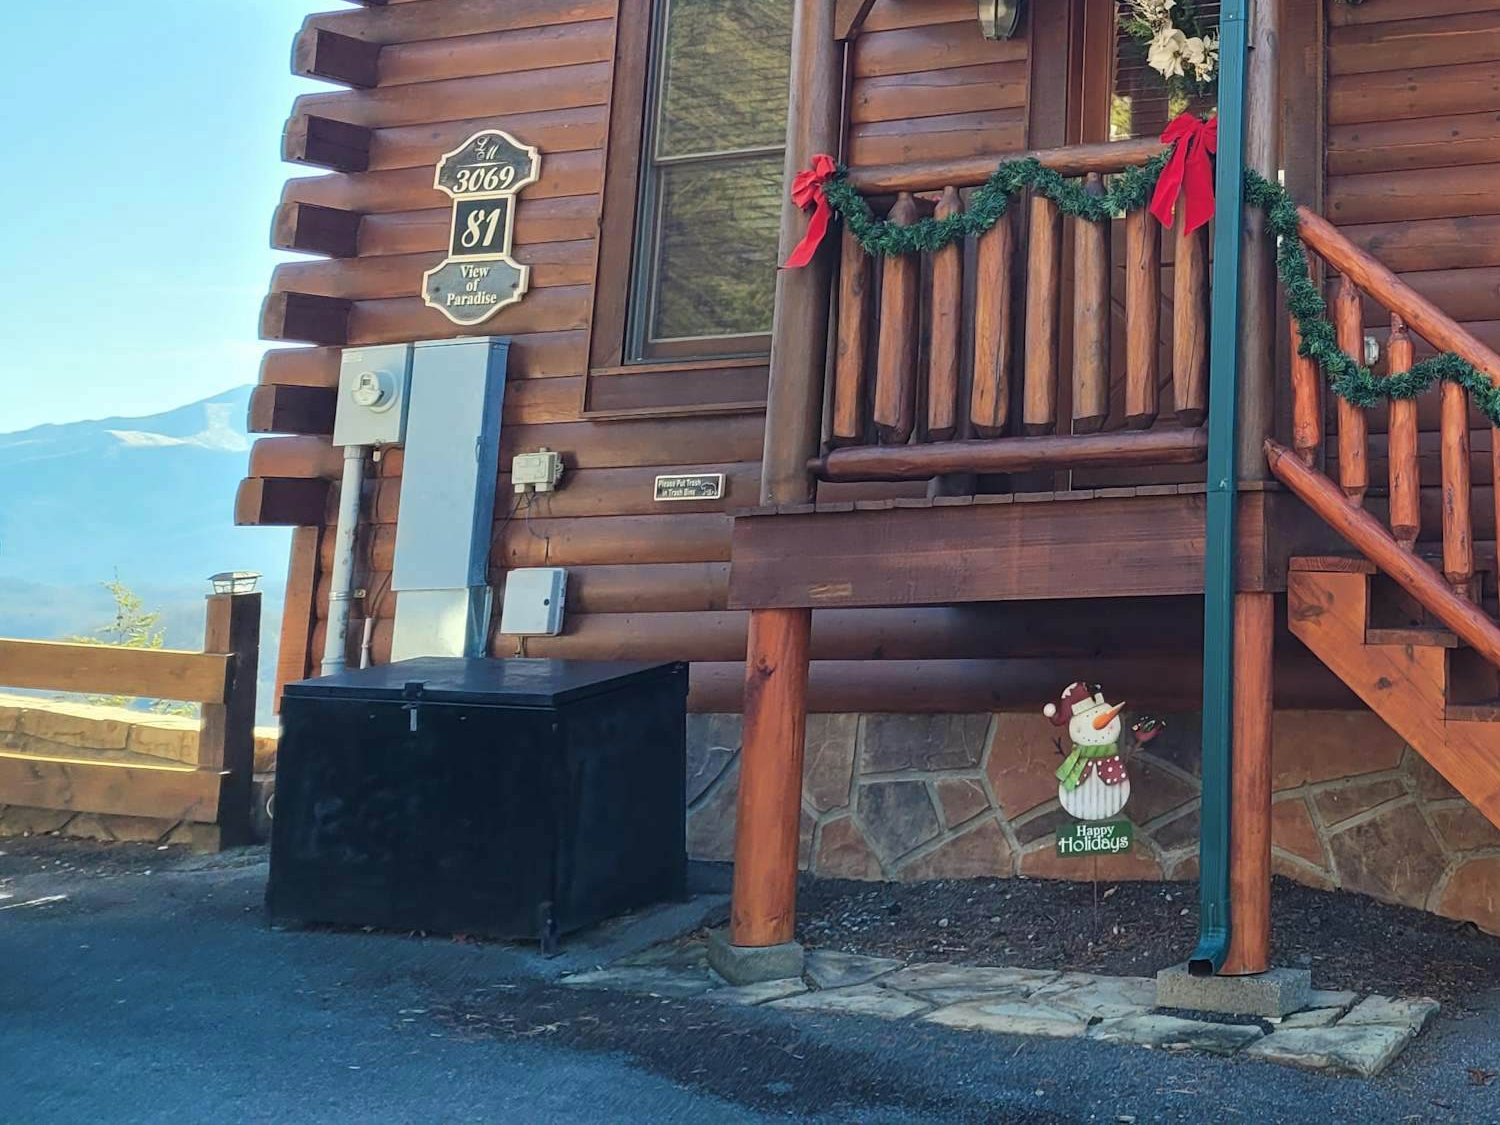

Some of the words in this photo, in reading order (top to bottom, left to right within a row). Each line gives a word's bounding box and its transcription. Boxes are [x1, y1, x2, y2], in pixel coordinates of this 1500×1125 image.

[453, 166, 515, 193] 3069
[461, 208, 502, 248] 81
[460, 264, 490, 278] View
[466, 278, 480, 292] of
[446, 291, 497, 306] Paradise
[1076, 825, 1115, 838] Happy
[1058, 836, 1129, 853] Holidays
